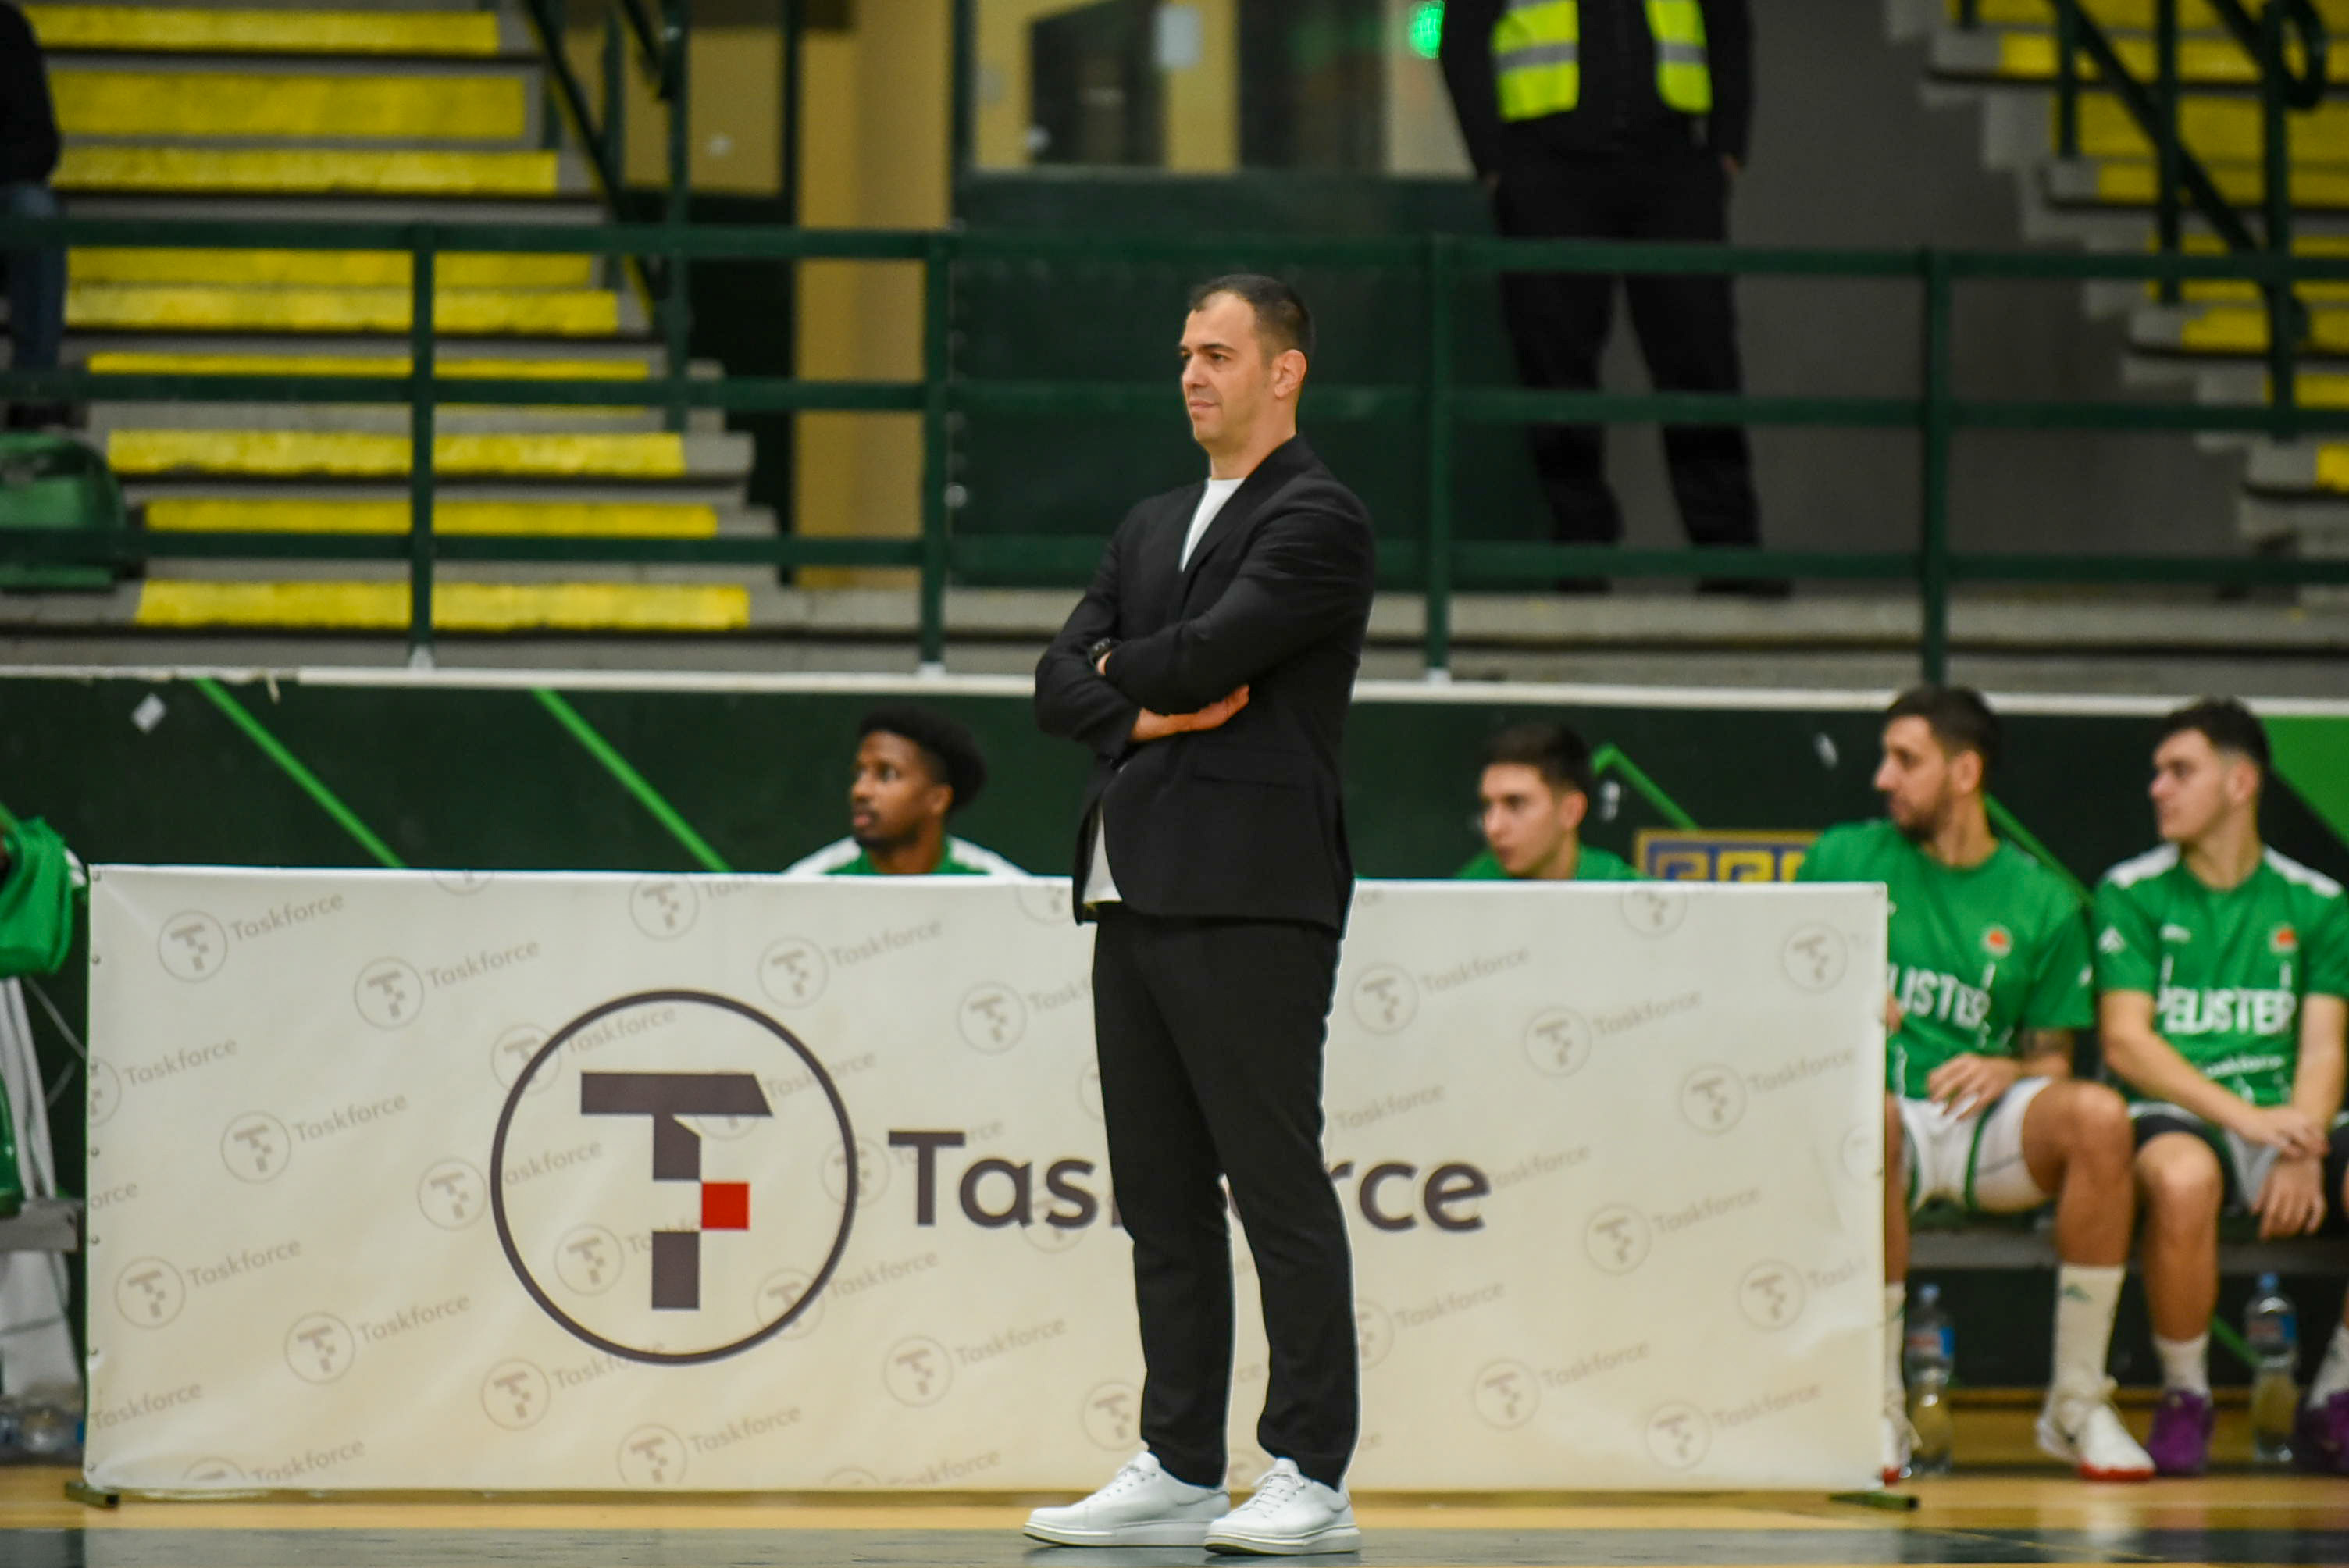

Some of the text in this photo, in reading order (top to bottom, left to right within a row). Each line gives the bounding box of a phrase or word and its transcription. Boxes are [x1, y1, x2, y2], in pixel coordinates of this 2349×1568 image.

[229, 893, 344, 942] Taskforce
[426, 941, 540, 989] Taskforce
[829, 921, 943, 968] Taskforce
[1420, 946, 1530, 992] Taskforce
[1592, 992, 1702, 1036] Taskforce
[123, 1038, 237, 1086] Taskforce
[1748, 1048, 1855, 1093] Taskforce
[293, 1094, 408, 1142] Taskforce
[1335, 1084, 1445, 1130] Taskforce
[504, 1141, 601, 1185] askforce
[1490, 1145, 1592, 1188] askforce
[1653, 1188, 1761, 1234] Taskforce
[187, 1239, 302, 1288] Taskforce
[357, 1293, 470, 1345] Taskforce
[1395, 1282, 1504, 1329] Taskforce
[955, 1318, 1068, 1367] Taskforce
[1542, 1341, 1651, 1388] Taskforce
[92, 1383, 202, 1431] Taskforce
[1713, 1384, 1822, 1428] Taskforce
[690, 1406, 800, 1454] Taskforce
